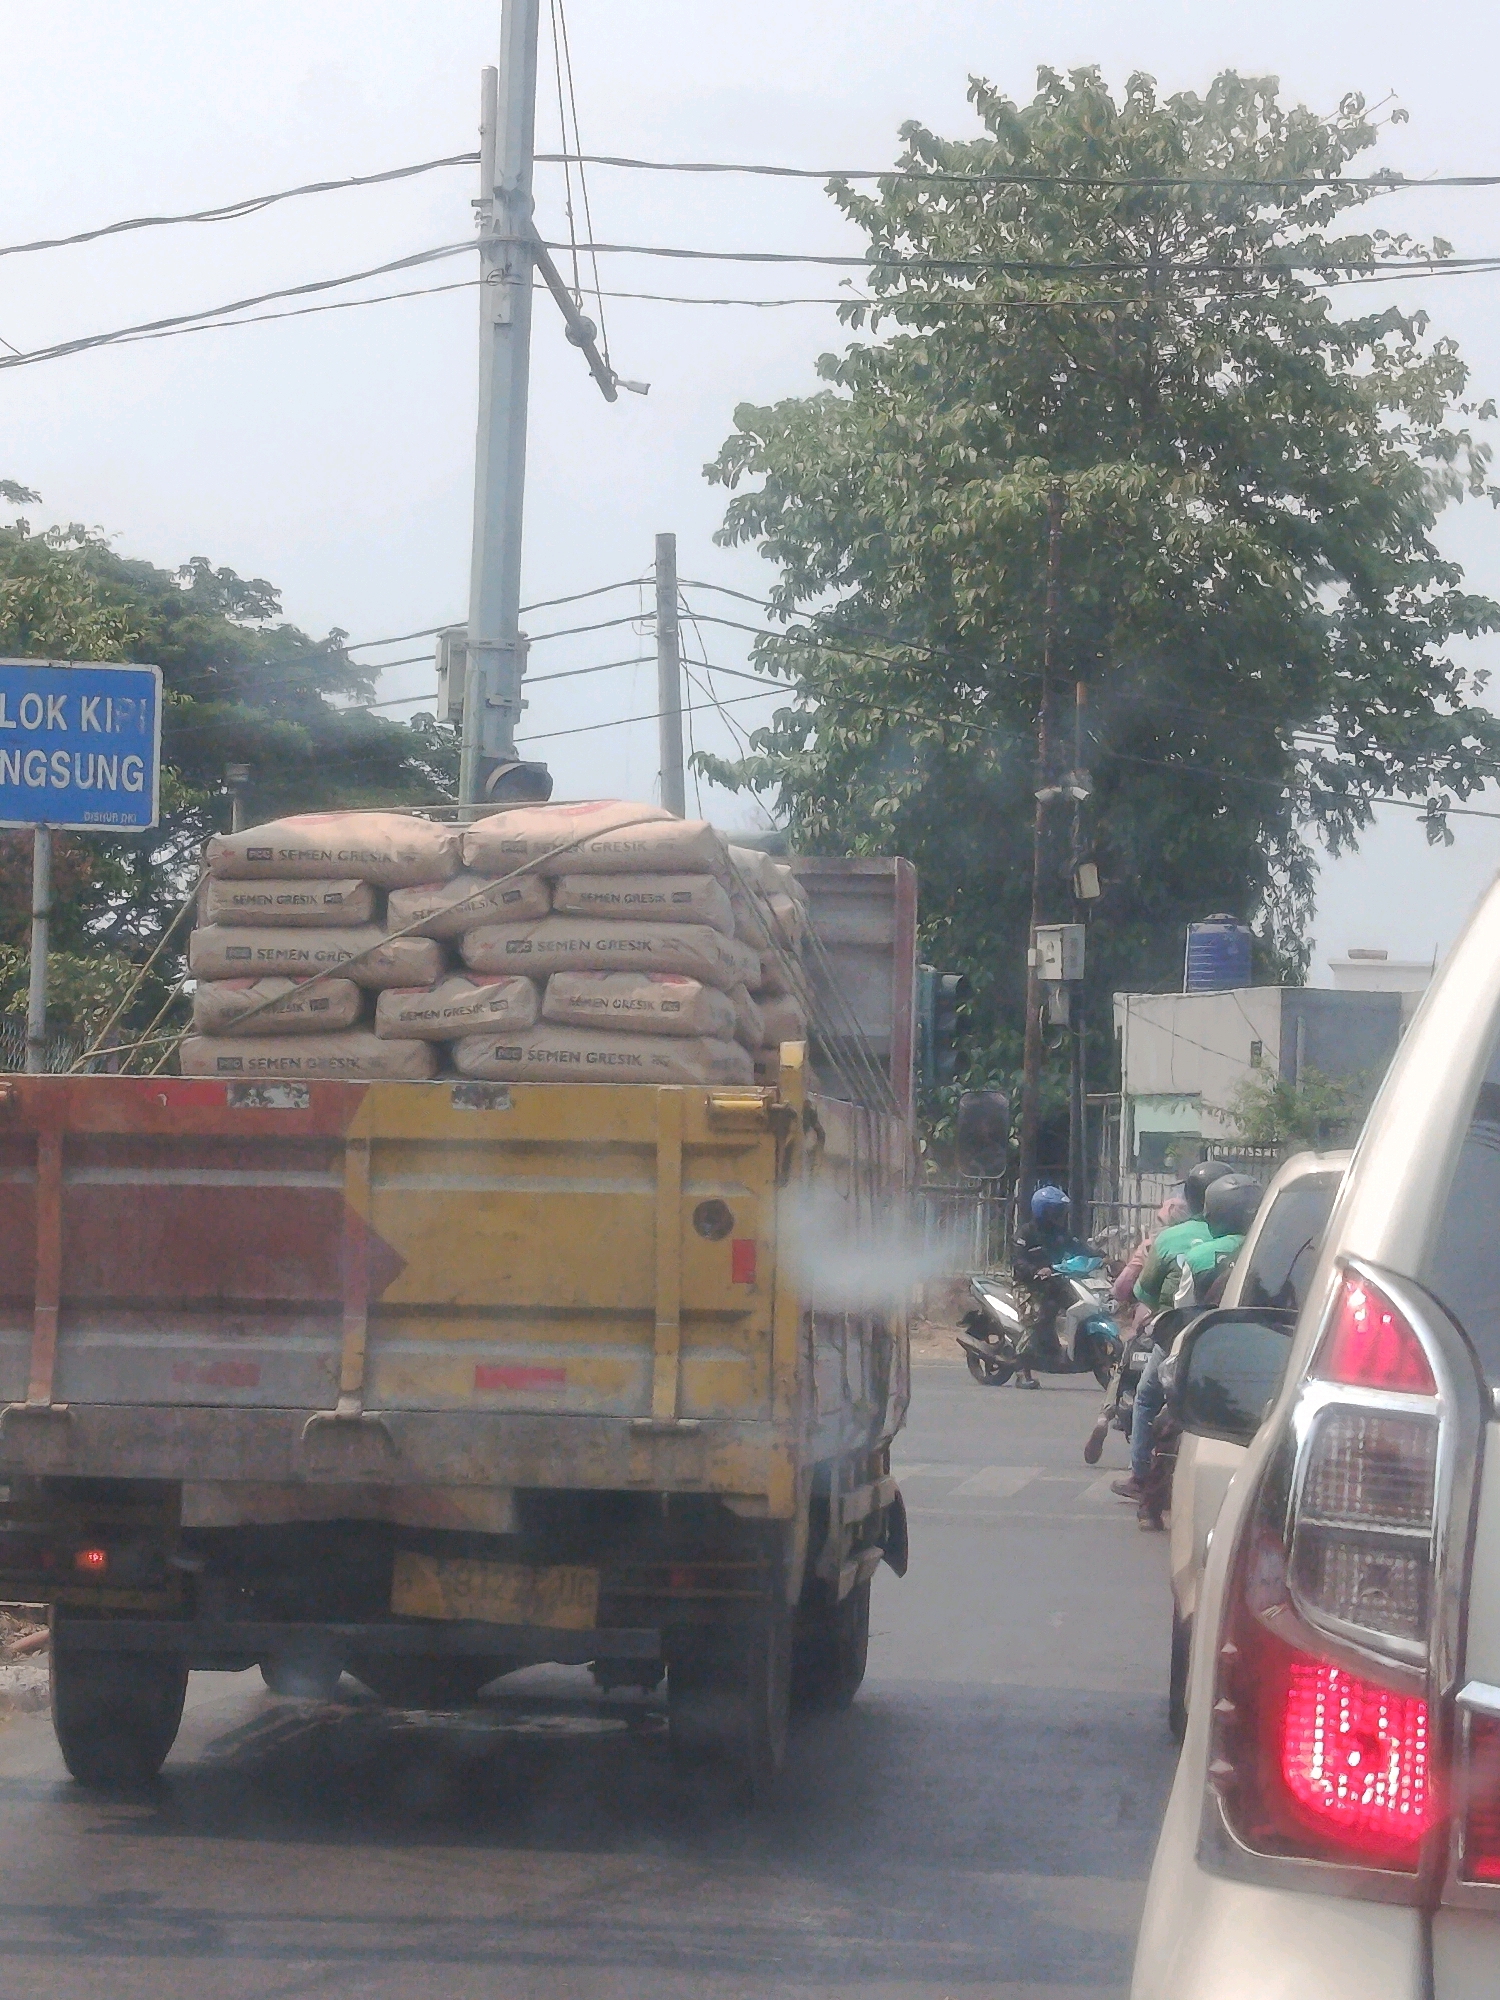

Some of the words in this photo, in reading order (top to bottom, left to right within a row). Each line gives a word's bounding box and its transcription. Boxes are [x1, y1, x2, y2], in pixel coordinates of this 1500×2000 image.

[0, 692, 68, 731] LOK
[0, 749, 144, 793] NGSUNG
[591, 841, 647, 853] GRESIK
[278, 849, 332, 862] SEMEN
[338, 850, 393, 863] GRESIK
[232, 894, 273, 905] SEMEN
[276, 893, 318, 906] GRESIK
[580, 892, 621, 905] SEMEN
[624, 892, 666, 905] GRESIK
[537, 939, 590, 951] SEMEN
[596, 939, 652, 952] GRESIK
[257, 949, 310, 962] SEMEN
[613, 998, 655, 1011] GRESIK
[400, 1009, 440, 1021] SEMEN
[444, 1002, 485, 1018] GRESIK
[248, 1057, 301, 1070] SEMEN
[307, 1057, 360, 1070] GESIK
[526, 1050, 581, 1064] SEMEN
[586, 1052, 643, 1067] GRESIK
